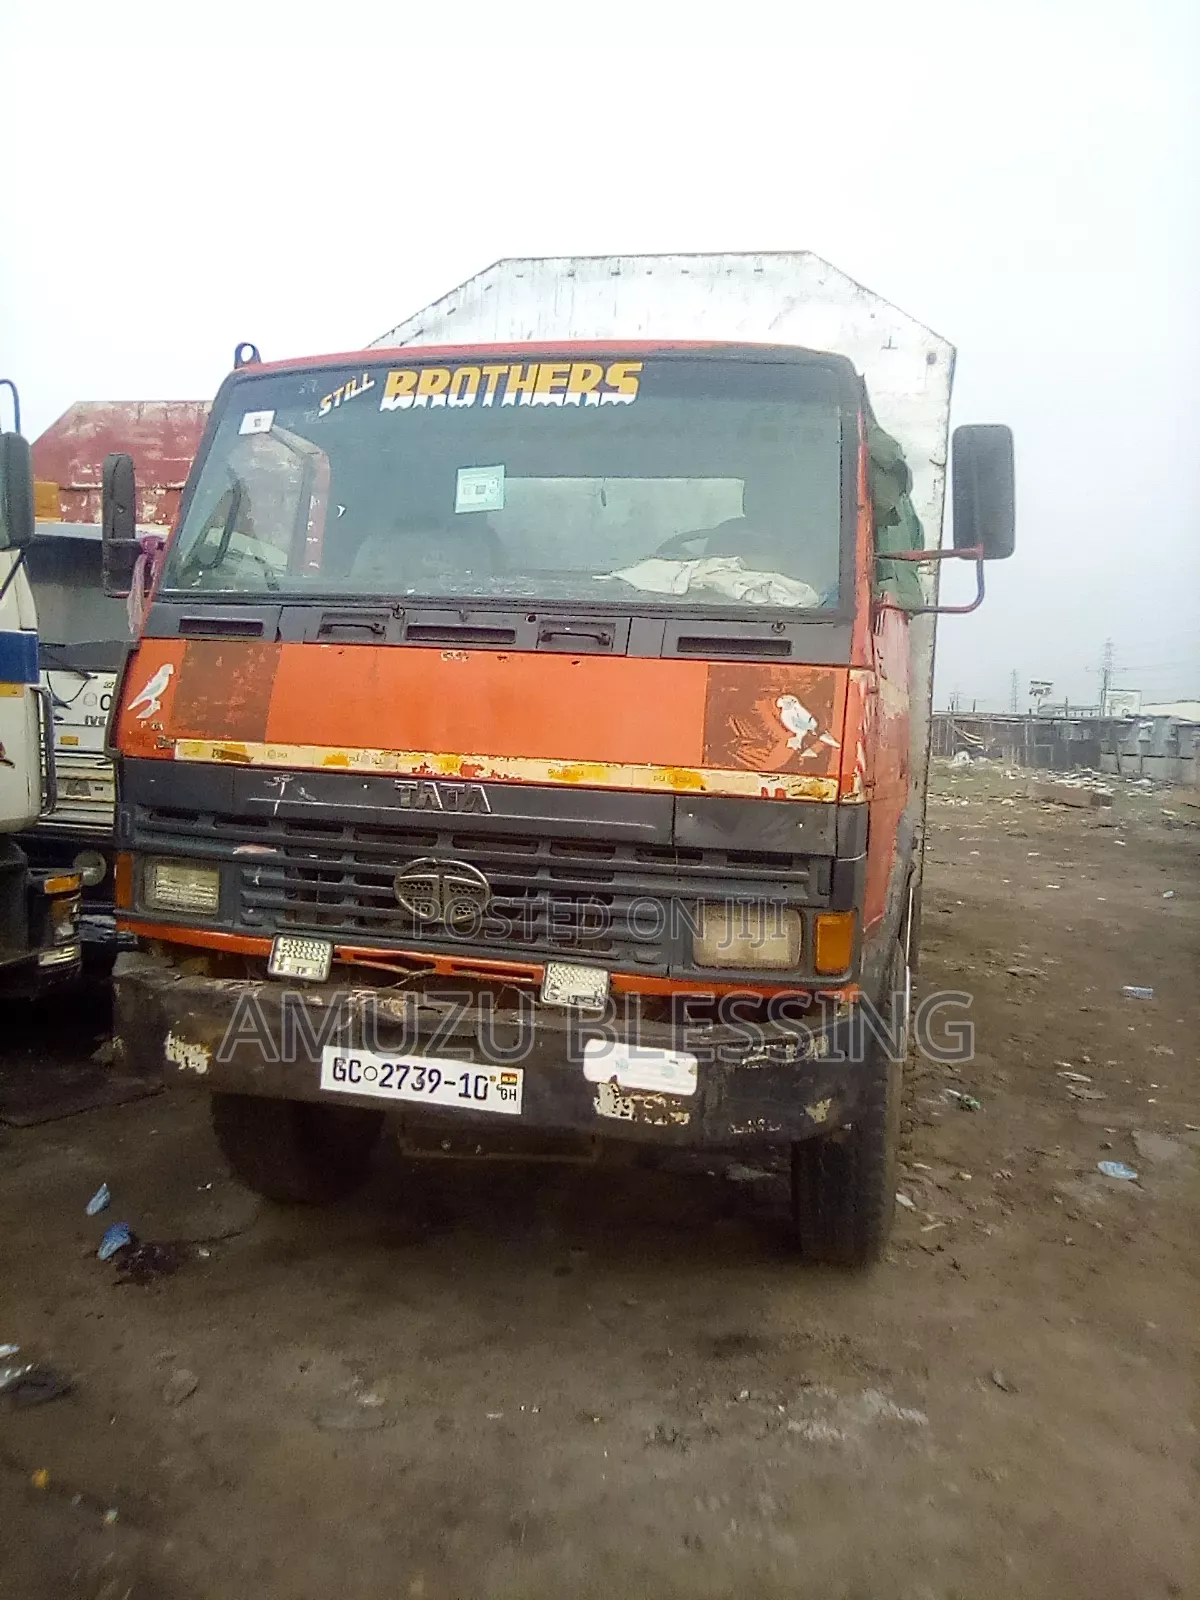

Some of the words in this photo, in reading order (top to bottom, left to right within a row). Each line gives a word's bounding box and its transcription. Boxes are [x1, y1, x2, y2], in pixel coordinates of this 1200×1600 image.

[318, 372, 376, 418] STILL
[379, 361, 643, 412] BROTHERS
[394, 779, 492, 815] TATA
[332, 1056, 362, 1083] GC
[378, 1062, 489, 1101] 2739-10
[500, 1087, 517, 1101] GH
